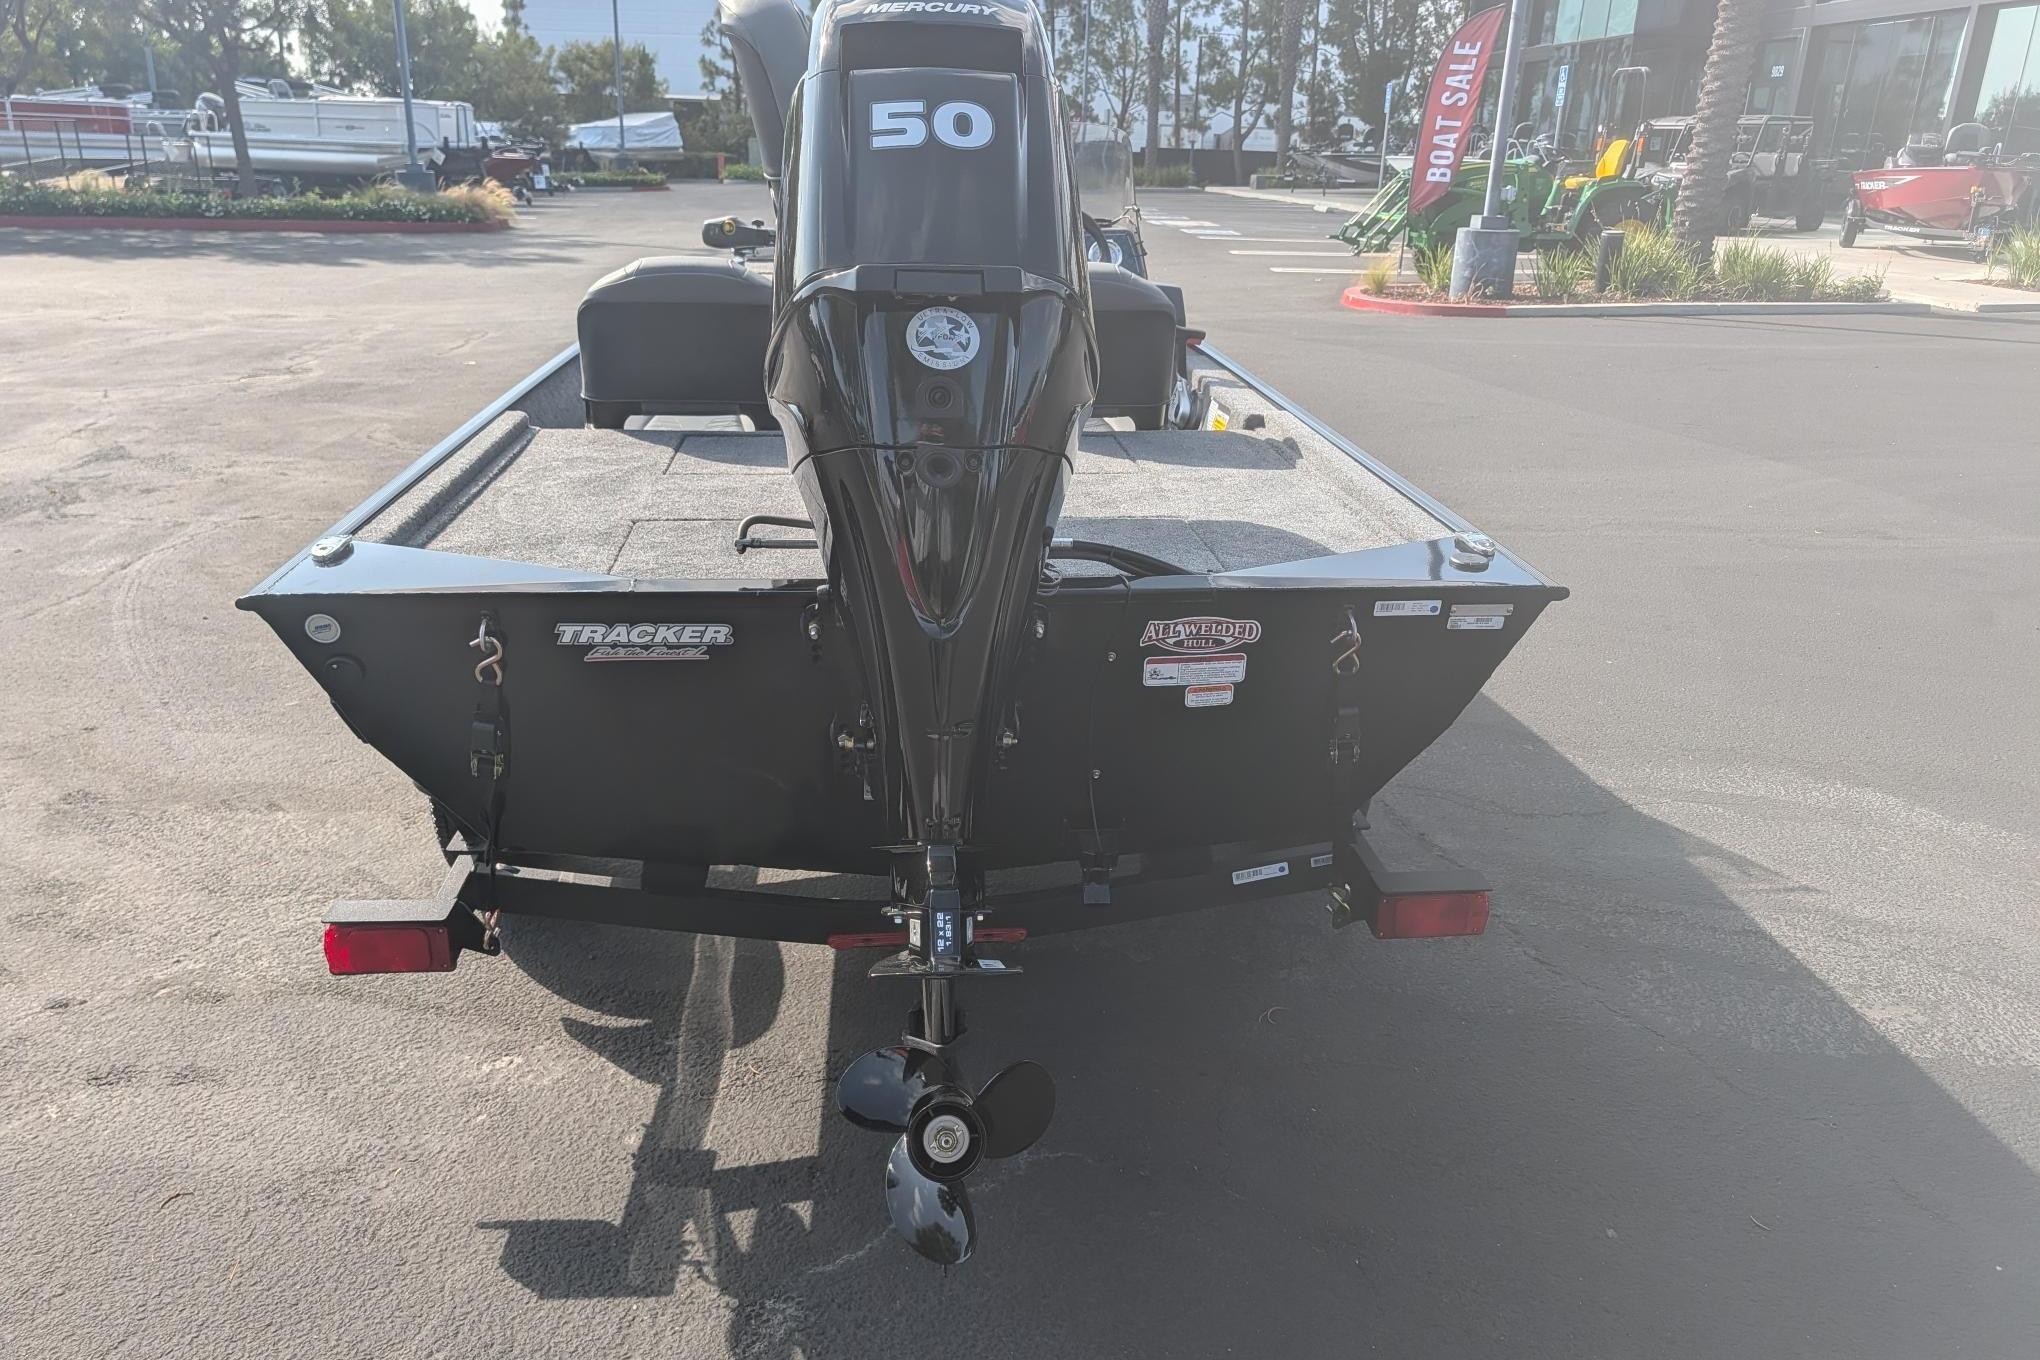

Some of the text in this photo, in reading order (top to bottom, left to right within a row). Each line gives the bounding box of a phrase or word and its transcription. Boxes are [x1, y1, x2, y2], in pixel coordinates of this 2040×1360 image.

[862, 2, 1001, 16] MERCURY
[1426, 41, 1482, 183] BOAT SALE
[870, 100, 995, 149] 50
[1145, 622, 1258, 641] ALL WELDED
[1183, 639, 1217, 647] HULL
[936, 912, 944, 928] 22
[936, 938, 944, 952] 12
